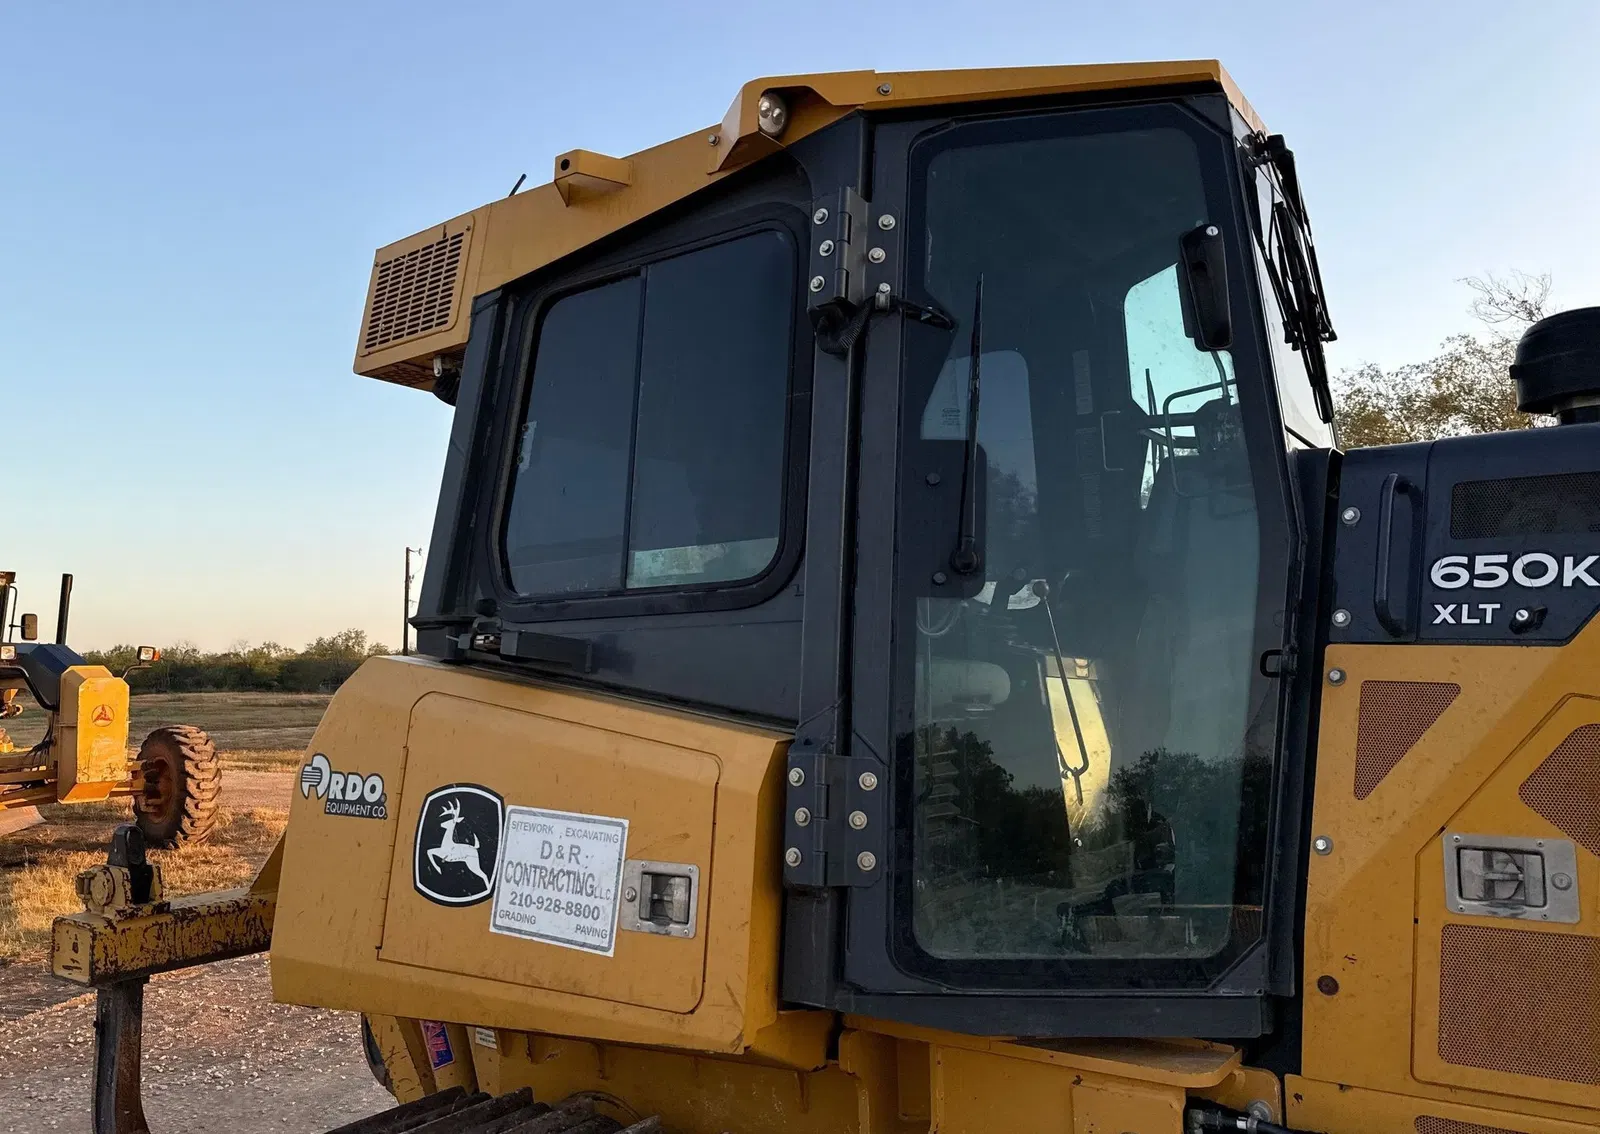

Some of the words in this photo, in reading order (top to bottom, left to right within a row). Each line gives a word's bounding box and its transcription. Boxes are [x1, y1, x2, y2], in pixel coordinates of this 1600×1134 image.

[1430, 553, 1600, 588] 650K
[1433, 604, 1501, 624] XLT
[326, 802, 371, 816] EQUIPMENT
[372, 806, 387, 818] CO.
[511, 821, 554, 835] SITEWORK
[565, 827, 619, 843] EXCAVATING
[540, 840, 553, 860] D
[555, 844, 565, 860] &
[568, 844, 581, 865] R
[504, 860, 595, 897] CONTRACTING
[509, 891, 600, 920] 210-928-8800
[498, 909, 537, 925] GRADING
[574, 923, 608, 939] PAVING
